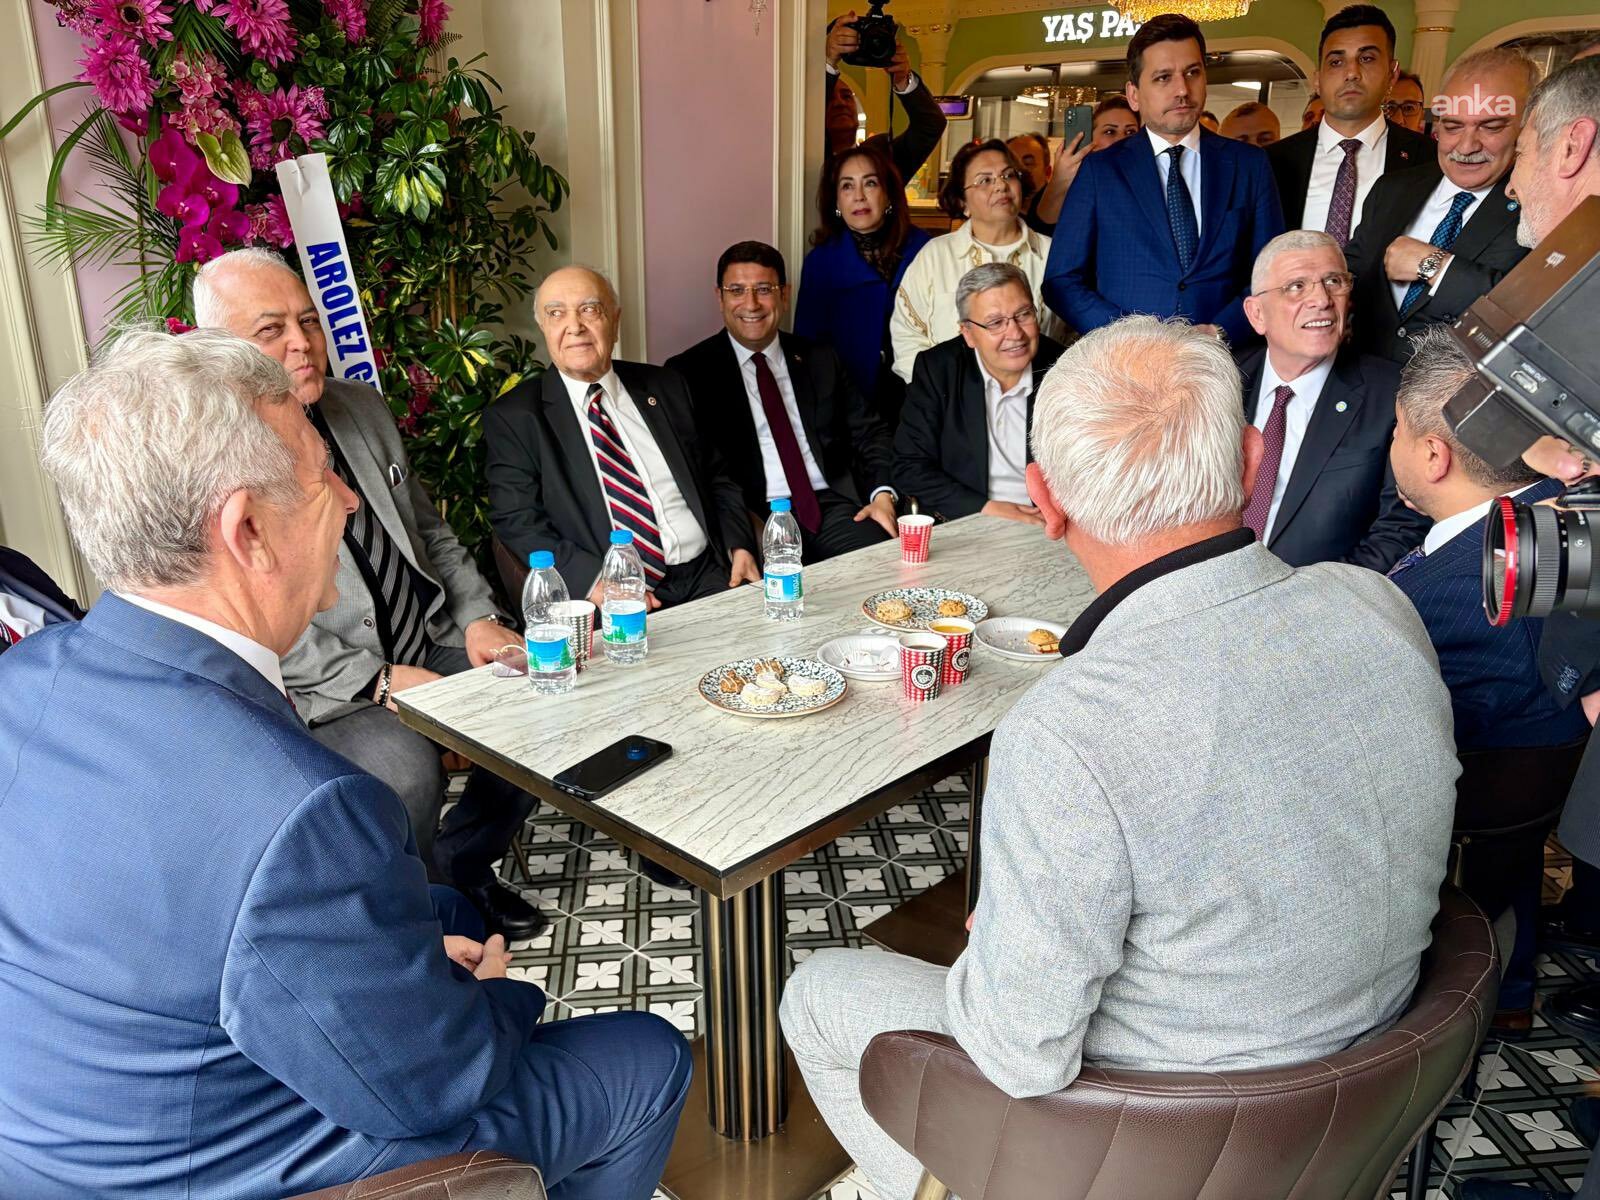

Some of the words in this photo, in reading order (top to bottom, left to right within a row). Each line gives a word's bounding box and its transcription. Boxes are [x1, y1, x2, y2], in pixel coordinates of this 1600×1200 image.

[1042, 12, 1094, 43] YAŞ
[1100, 10, 1141, 38] PA
[306, 241, 368, 362] AROLEZ
[344, 361, 377, 389] G
